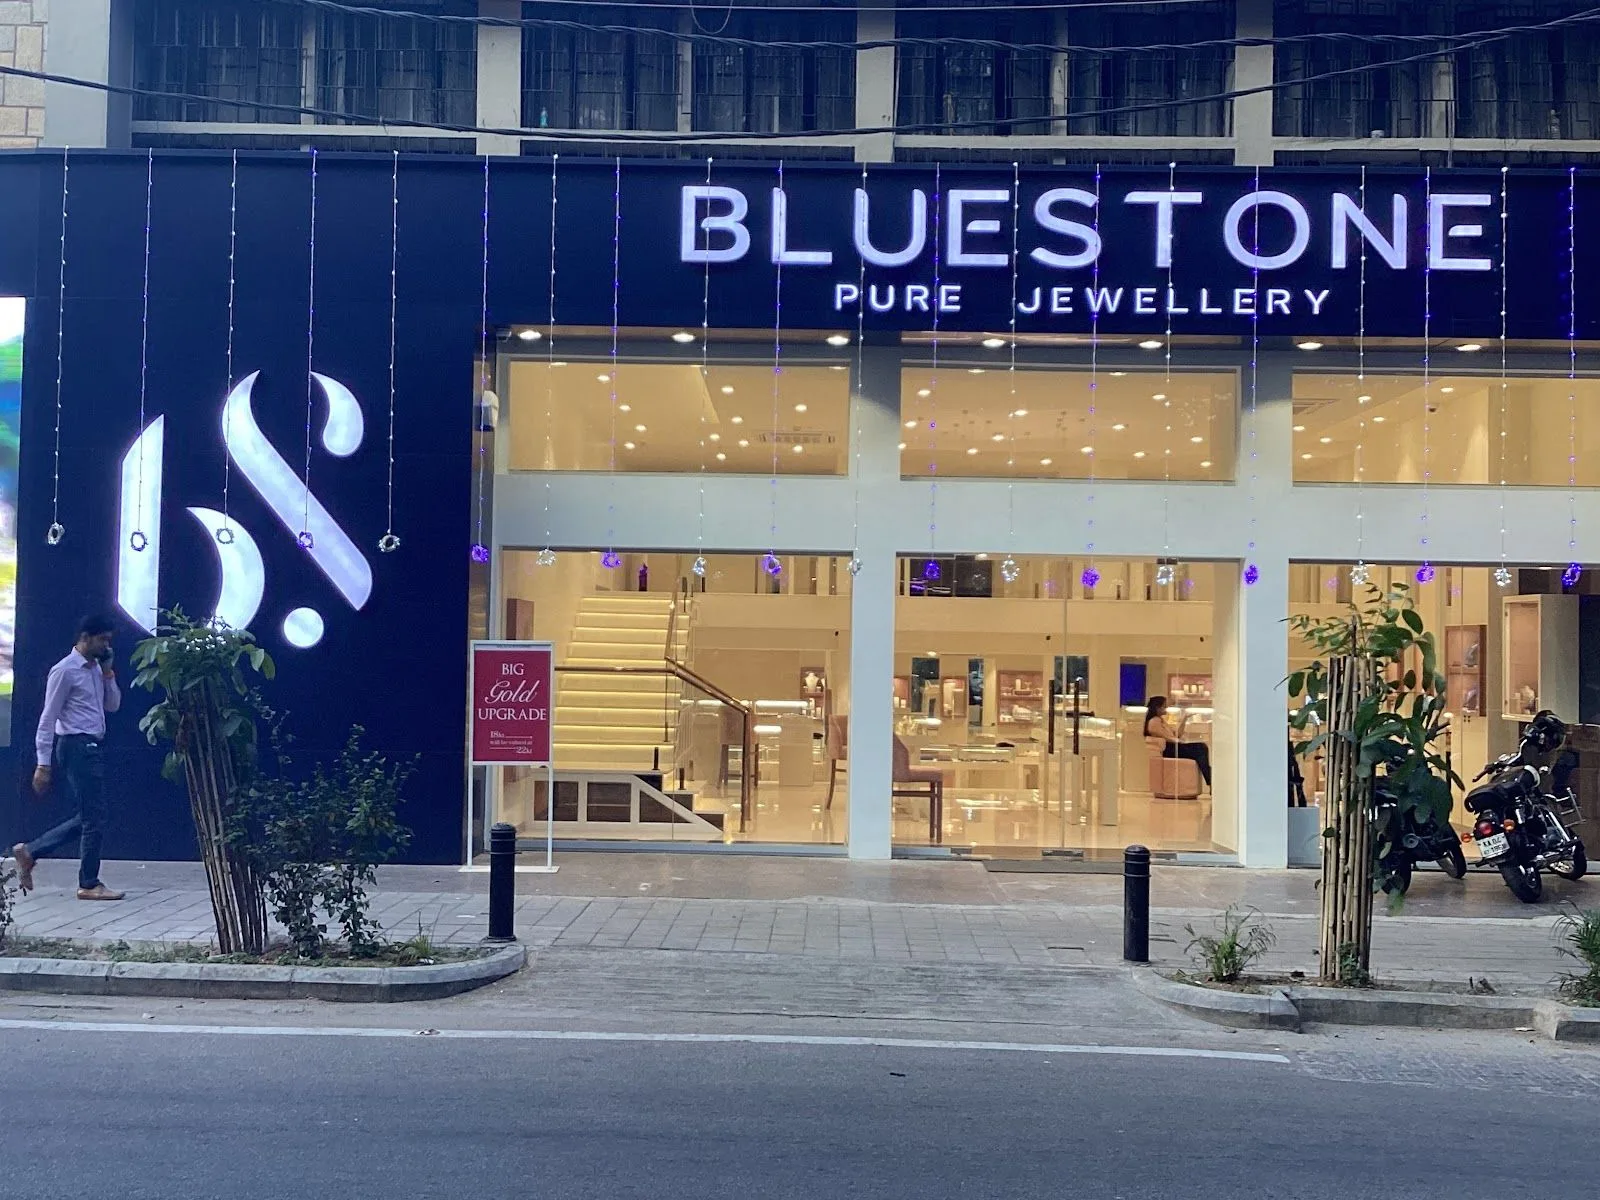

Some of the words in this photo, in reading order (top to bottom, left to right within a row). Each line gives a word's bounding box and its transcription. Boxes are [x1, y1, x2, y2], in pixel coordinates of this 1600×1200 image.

[680, 185, 1493, 272] BLUESTONE
[834, 283, 963, 313] PURE
[1017, 285, 1331, 317] JEWELLERY
[502, 663, 524, 675] BIG
[484, 679, 540, 704] Gold
[478, 708, 547, 720] UPGRADE
